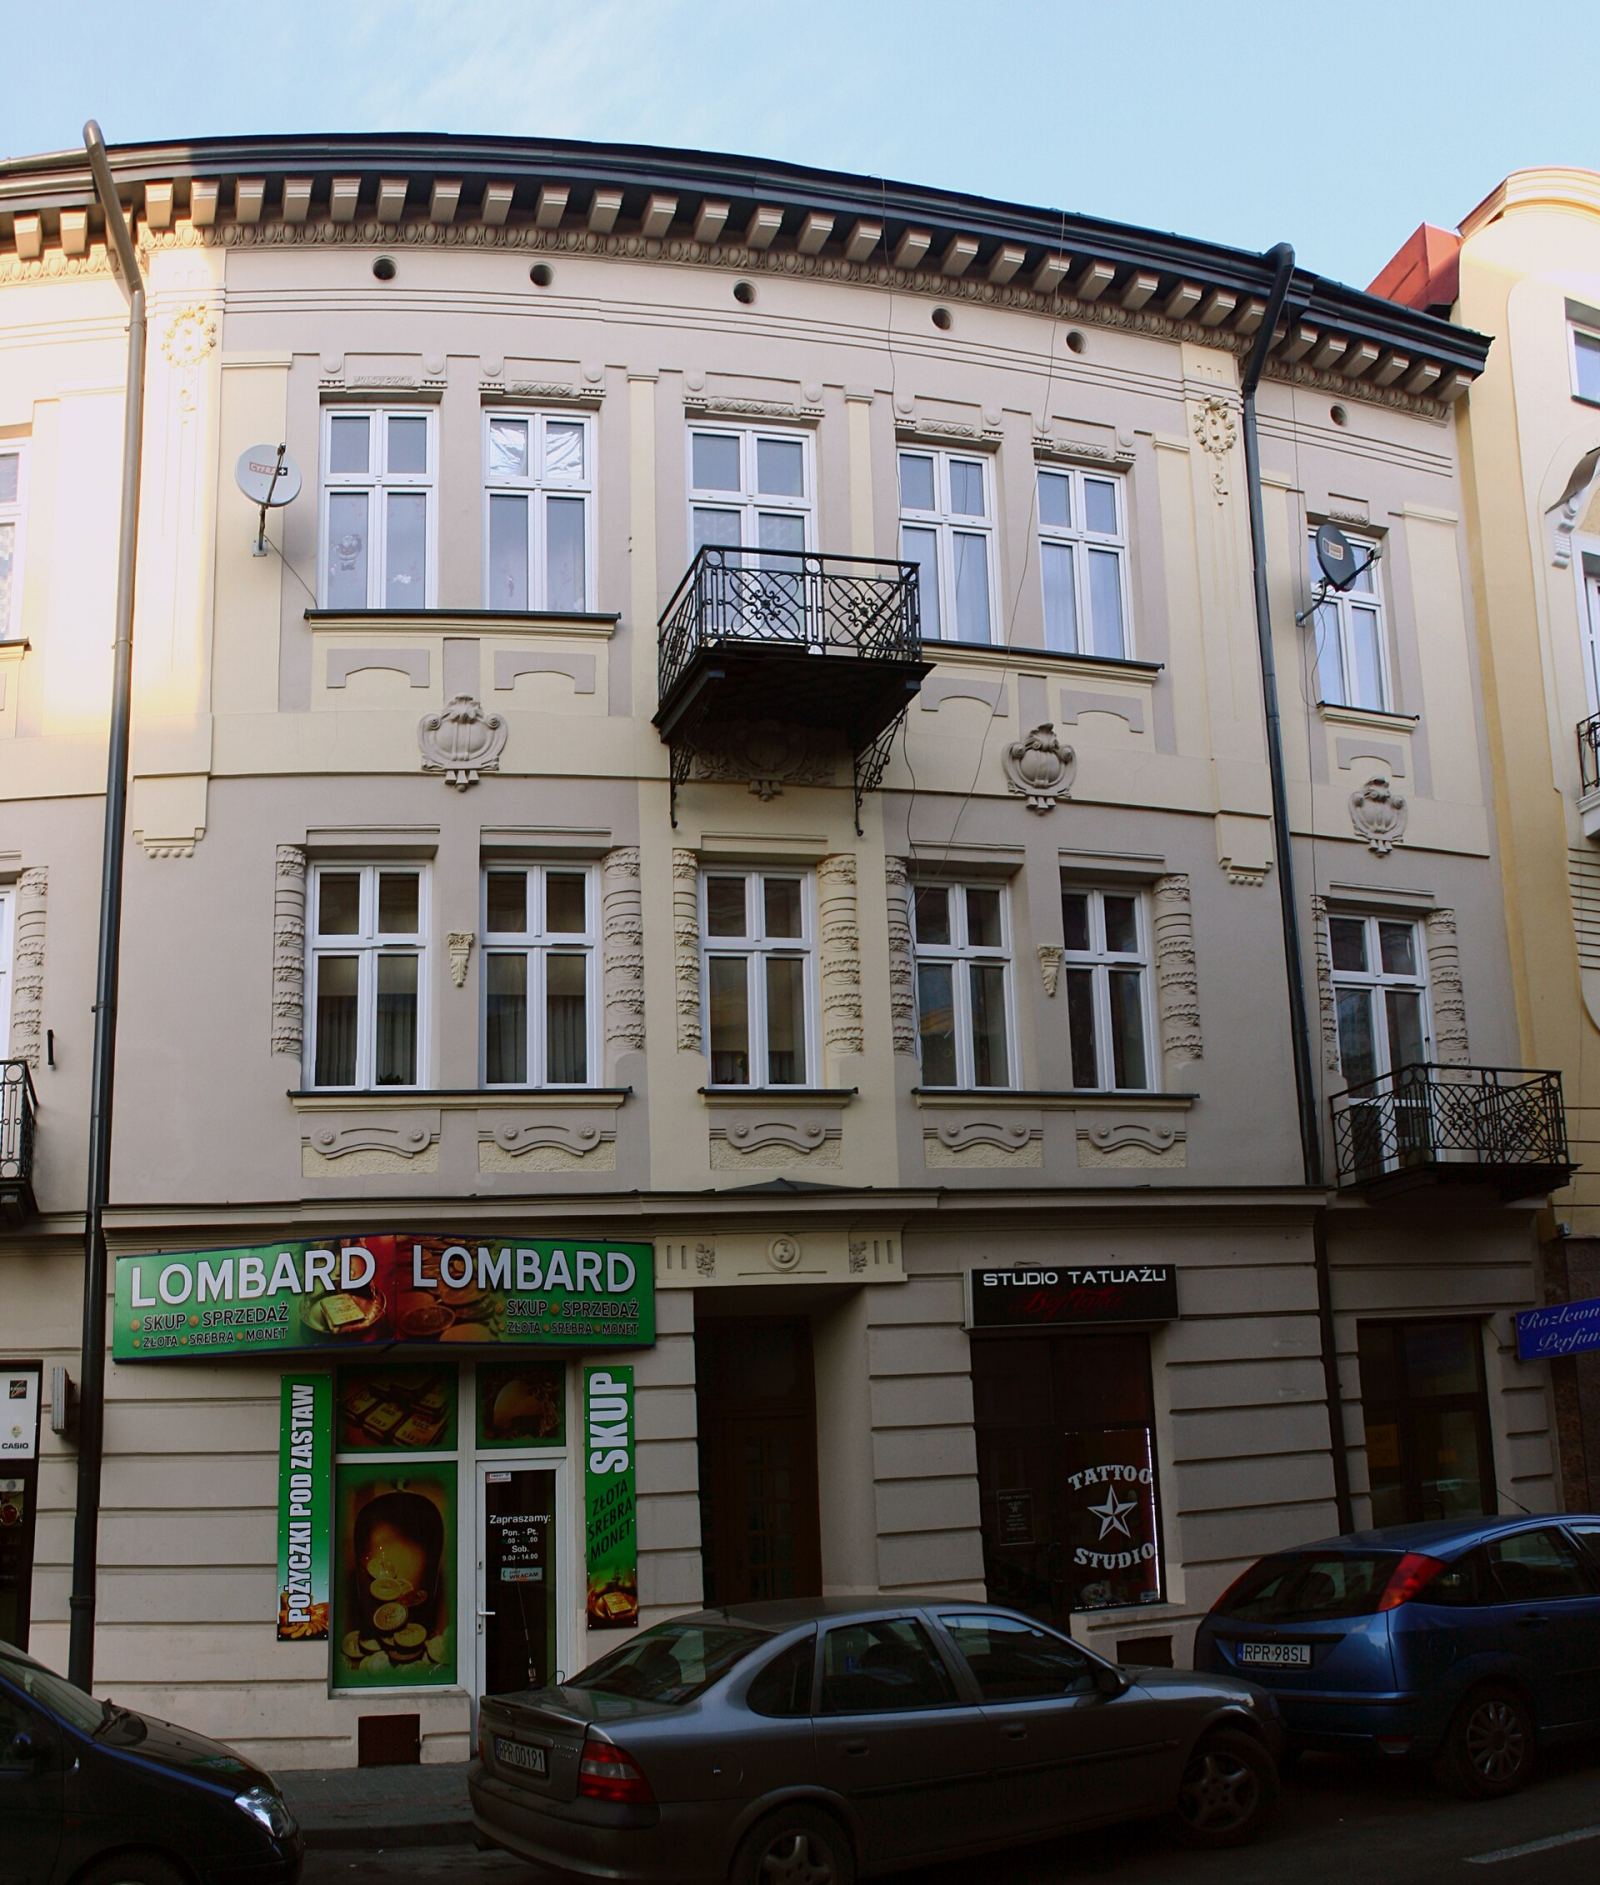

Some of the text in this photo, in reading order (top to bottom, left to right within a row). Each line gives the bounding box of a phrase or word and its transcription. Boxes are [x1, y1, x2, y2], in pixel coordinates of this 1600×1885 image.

[131, 1247, 376, 1307] LOMBARD
[413, 1244, 636, 1293] LOMBARD
[982, 1267, 1167, 1286] STUDIO TATUAŻU
[143, 1302, 289, 1331] SKUP SPRZEDAŻ
[506, 1298, 639, 1318] SKUP SPRZEDAŻ
[143, 1327, 288, 1348] ZŁOTA SREBRA MONET
[506, 1321, 638, 1335] ZŁOTA SREBRA MONET
[589, 1372, 630, 1475] SKUP
[1, 1442, 29, 1450] CASIO
[1067, 1464, 1152, 1491] TATTOO
[284, 1384, 315, 1624] POŻYCZKI POD ZASTAW
[592, 1479, 629, 1516] ZŁOTA
[489, 1513, 551, 1526] Zapraszamy:
[588, 1496, 634, 1542] SREBRA
[590, 1519, 632, 1565] MONET
[1073, 1543, 1155, 1569] STUDIO
[1245, 1644, 1308, 1663] RPR 98SL
[515, 1745, 543, 1770] 00191
